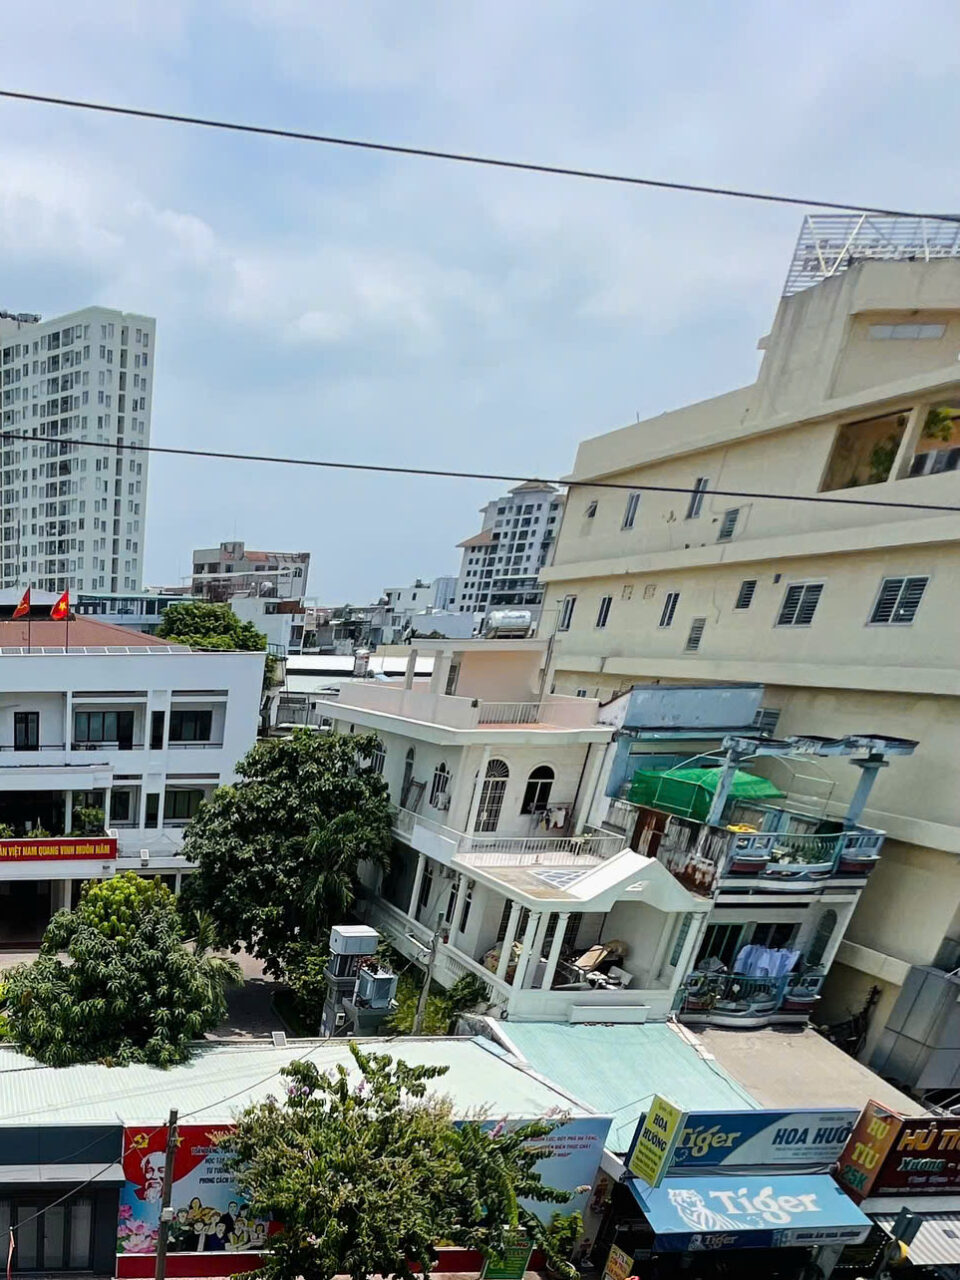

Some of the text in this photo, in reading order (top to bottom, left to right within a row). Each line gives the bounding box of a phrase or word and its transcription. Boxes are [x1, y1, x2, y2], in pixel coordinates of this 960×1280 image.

[8, 845, 21, 858] VIỆT
[22, 846, 37, 856] NAM
[38, 845, 58, 856] QUANG
[653, 1113, 668, 1132] HOA
[678, 1125, 741, 1157] Tiger
[771, 1128, 809, 1145] HOA
[709, 1186, 822, 1224] Tiger
[704, 1233, 738, 1248] Tiger
